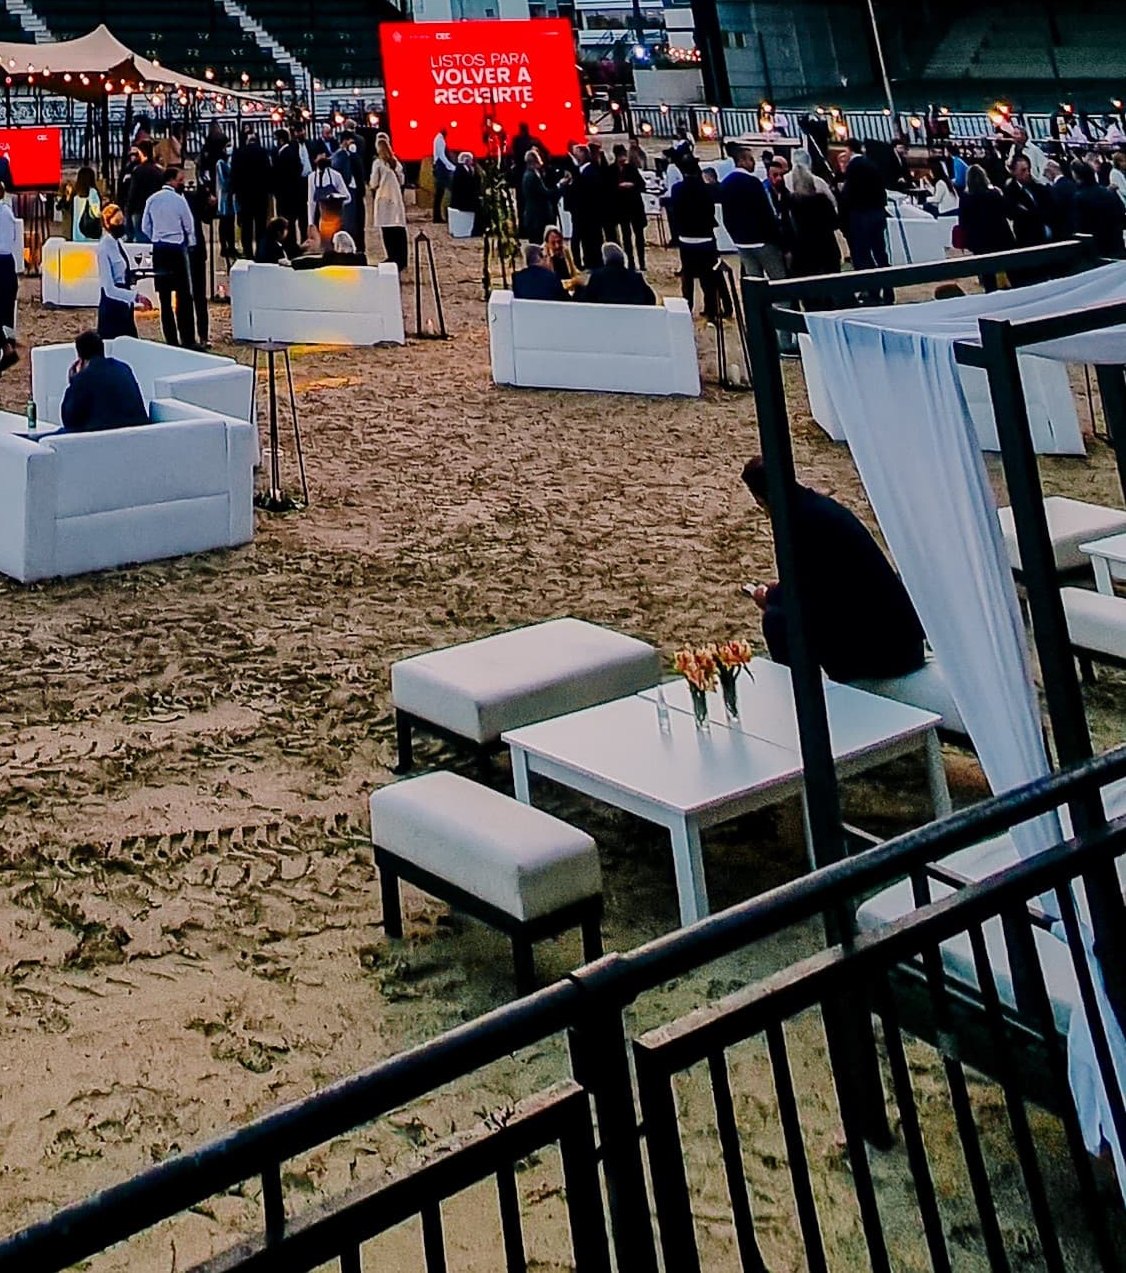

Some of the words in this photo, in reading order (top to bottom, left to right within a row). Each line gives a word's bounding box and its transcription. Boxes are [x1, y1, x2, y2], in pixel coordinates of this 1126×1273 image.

[430, 53, 486, 68] LISTOS
[490, 52, 530, 65] PARA
[431, 67, 511, 85] VOLVER
[517, 66, 532, 84] A
